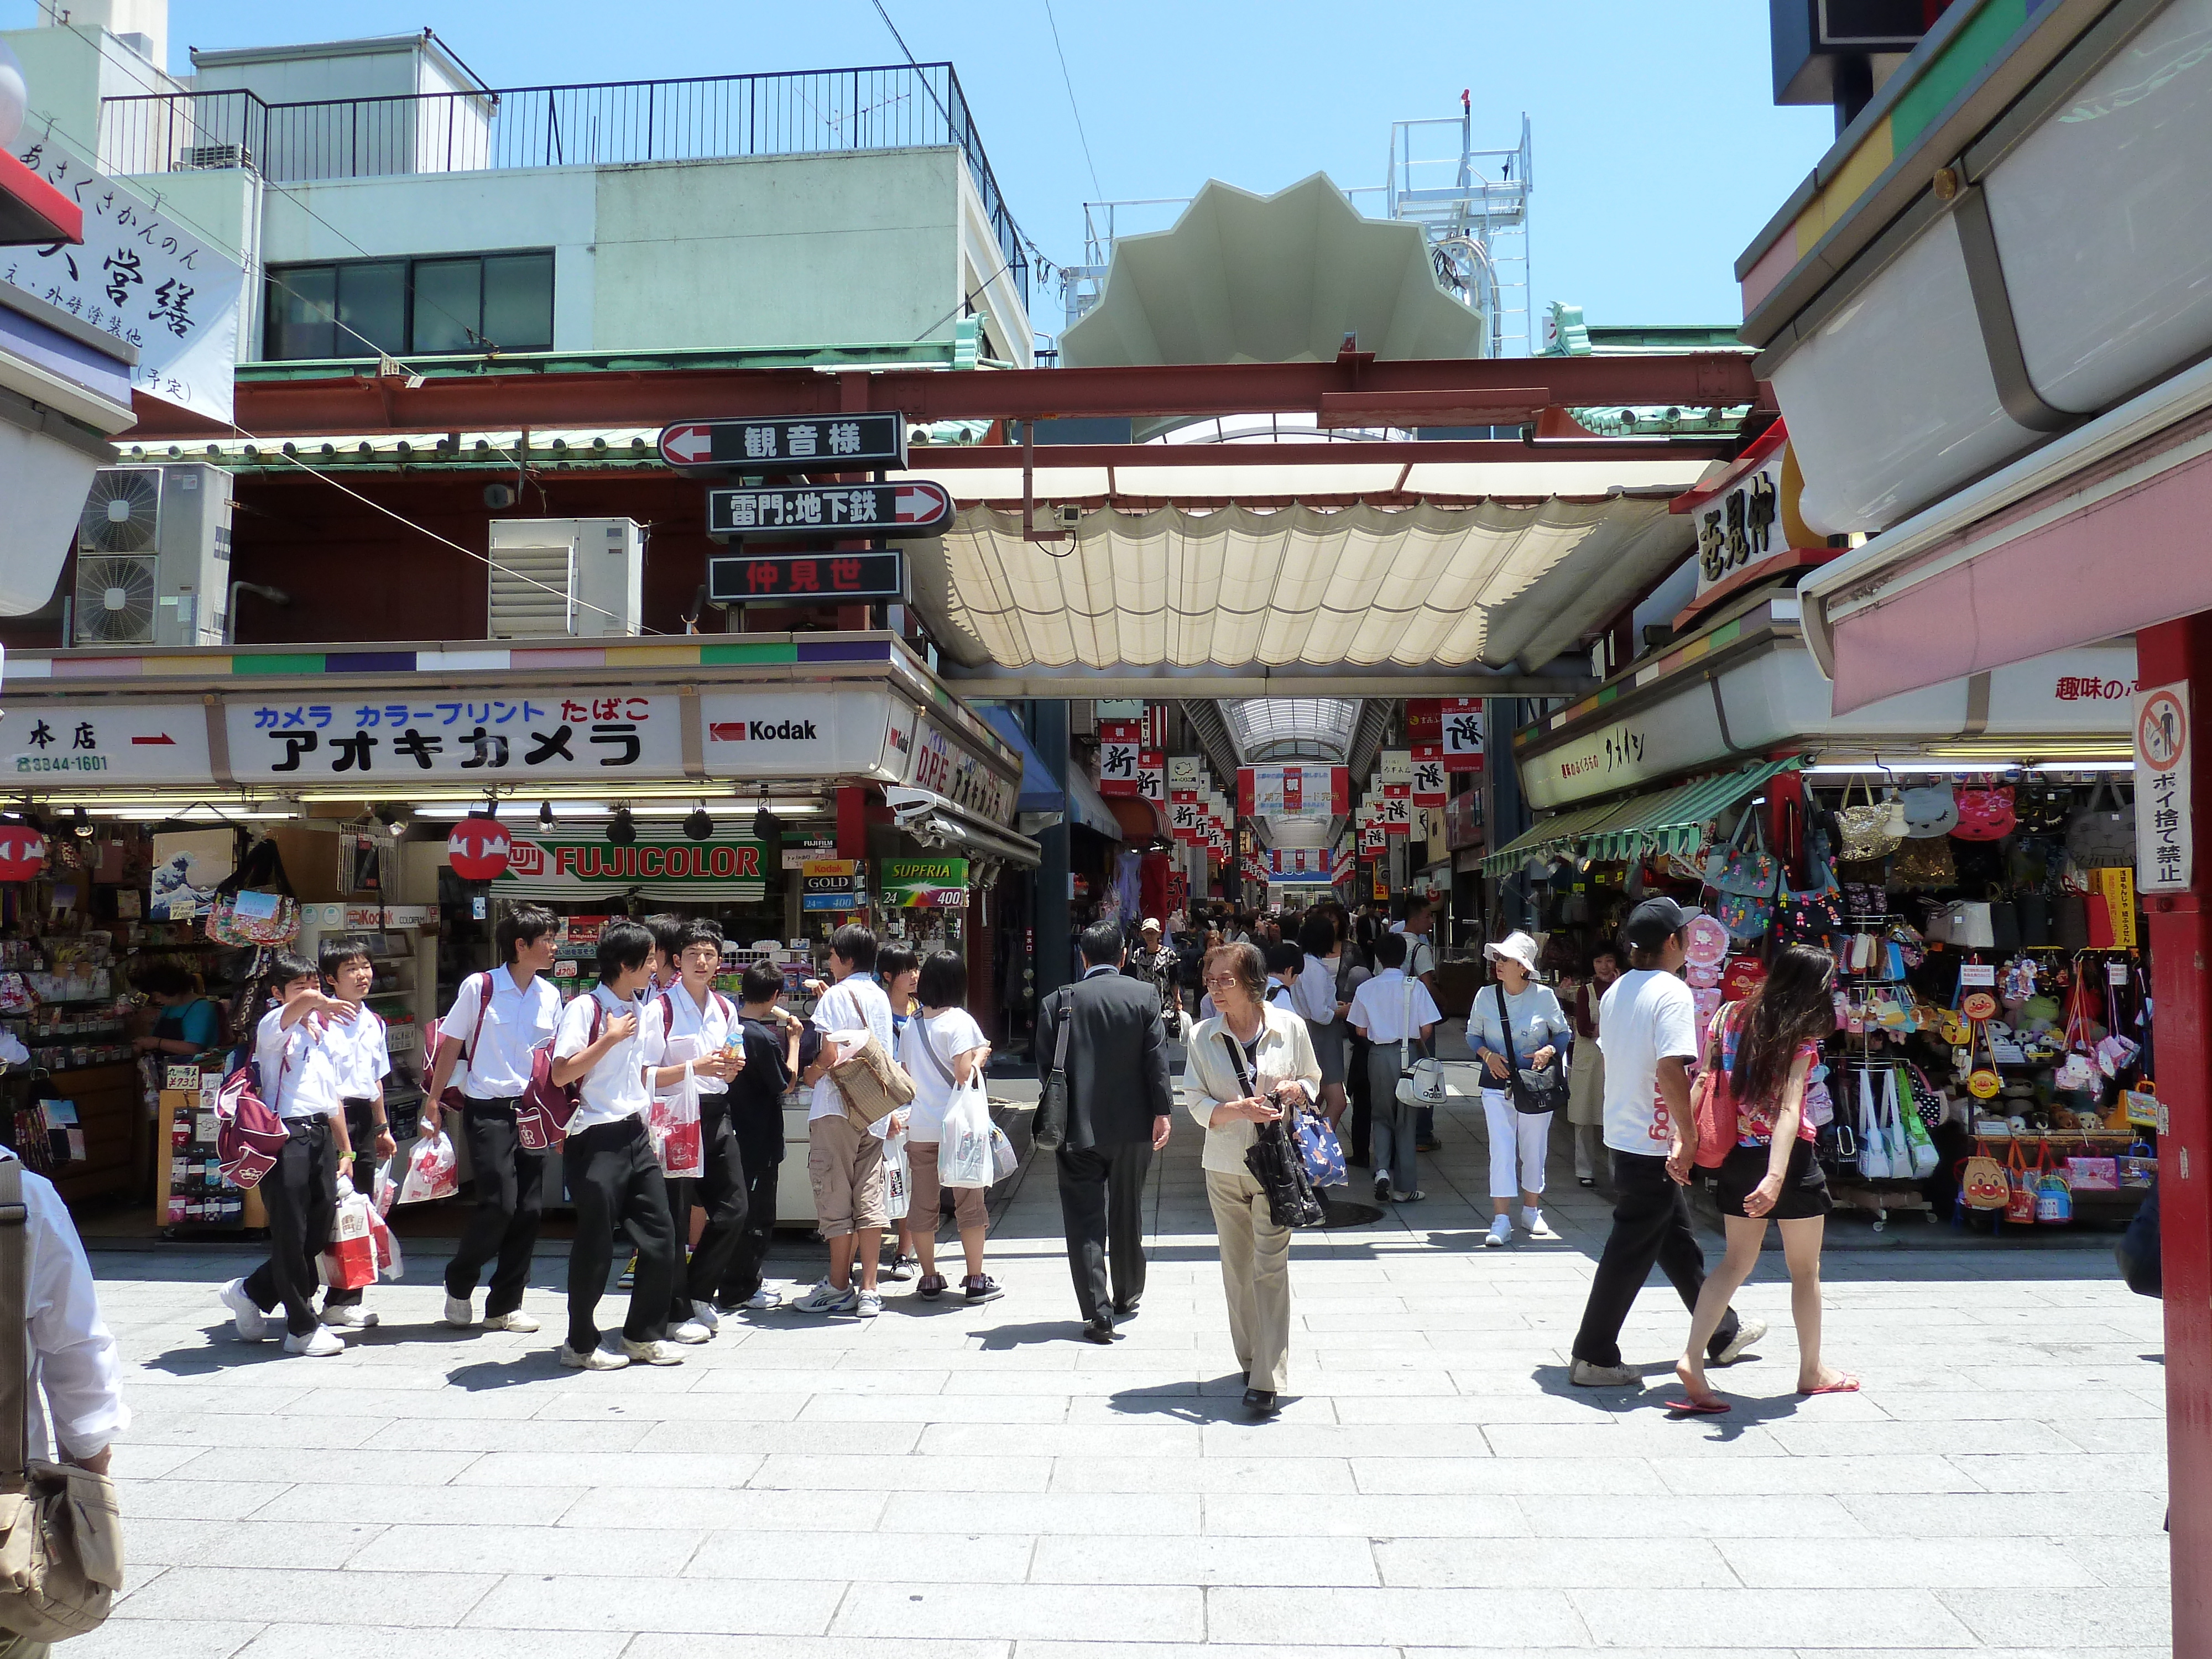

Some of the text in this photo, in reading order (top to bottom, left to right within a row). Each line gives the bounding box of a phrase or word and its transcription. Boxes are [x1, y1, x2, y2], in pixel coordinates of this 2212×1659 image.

[744, 422, 860, 457] 観音様
[747, 558, 862, 593] 仲見世
[254, 698, 649, 729] カメラ カラープリント たばこ
[28, 720, 97, 750] 本店
[750, 720, 817, 740] Kodak
[269, 724, 641, 771] アオキカメラ
[1103, 745, 1137, 777] 新
[1137, 770, 1161, 797] 新
[1286, 779, 1298, 791] 祝
[1173, 805, 1196, 827] 新
[2152, 772, 2183, 884] ポイ捨て禁止
[555, 846, 760, 877] FUJICOLOR
[814, 865, 843, 873] Kodak
[893, 864, 951, 878] SUPERIA
[808, 877, 849, 888] GOLD
[833, 899, 852, 907] 400
[883, 891, 961, 905] 24 400
[169, 1077, 196, 1088] ¥735
